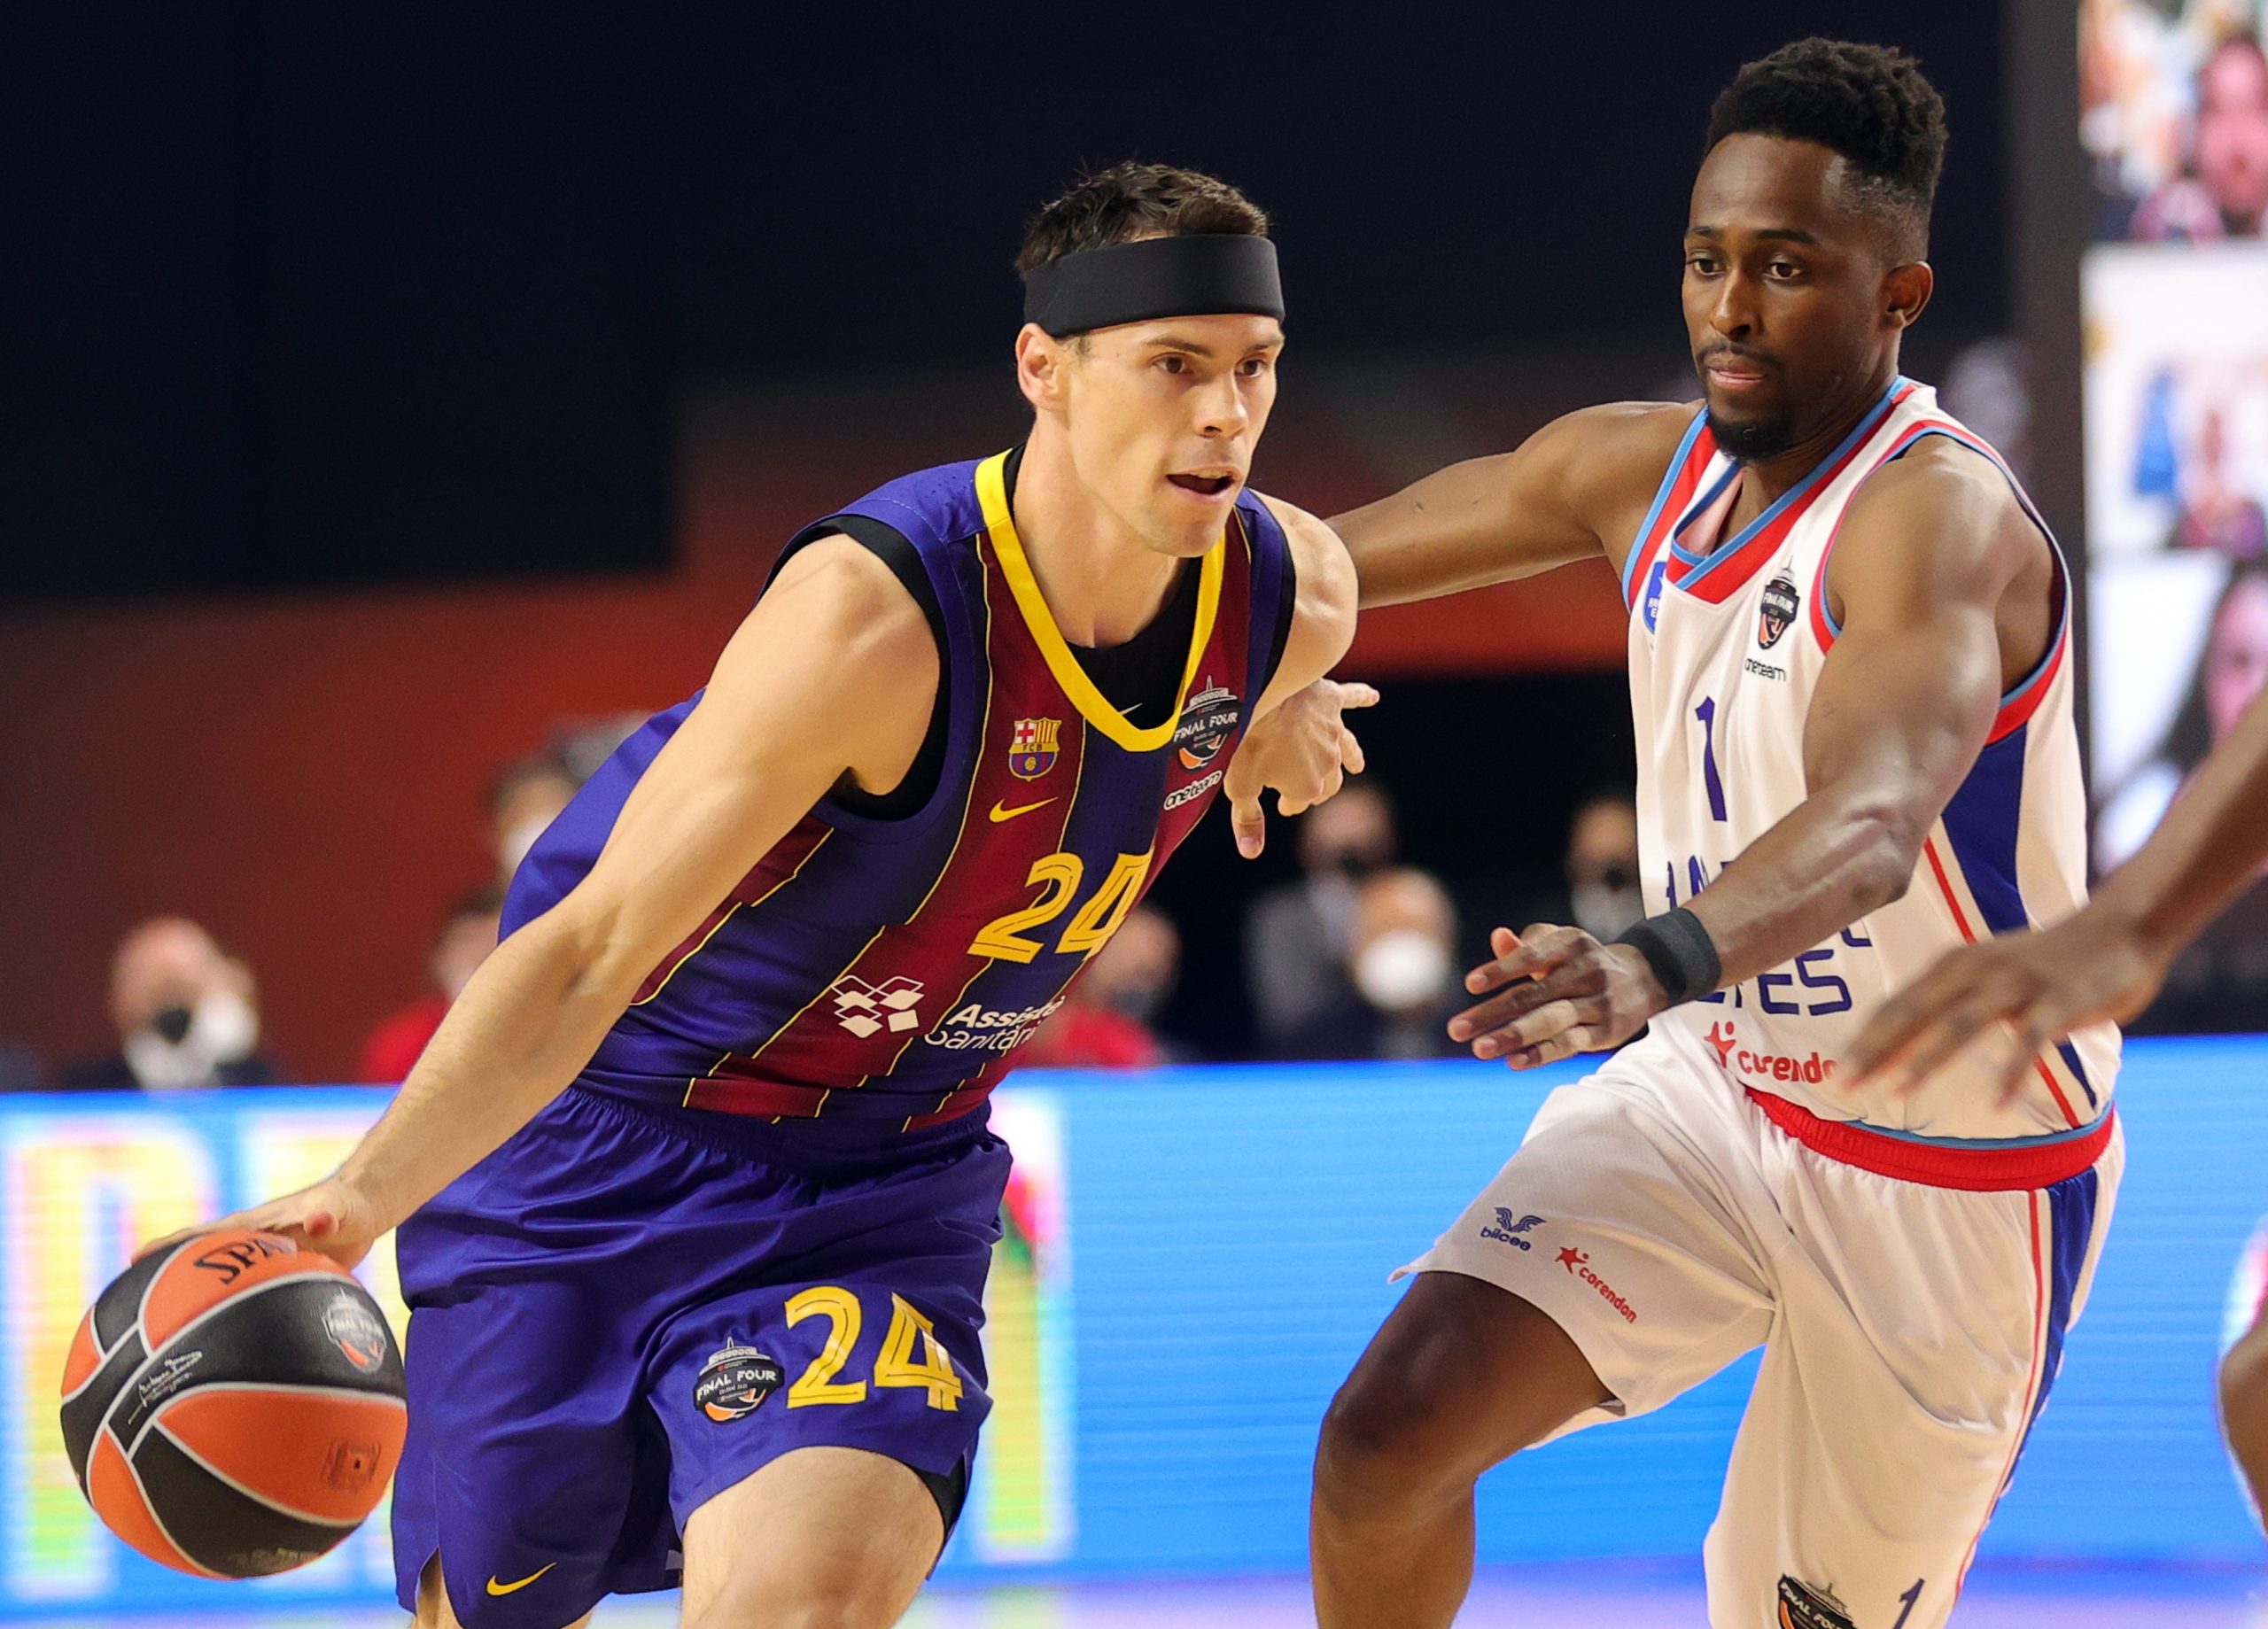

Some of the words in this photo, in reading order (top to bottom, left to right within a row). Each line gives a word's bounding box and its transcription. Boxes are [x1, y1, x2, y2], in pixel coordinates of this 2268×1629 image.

[1022, 743, 1043, 752] FCB
[1173, 719, 1206, 743] FINAL
[1208, 711, 1239, 728] FOUR
[1695, 695, 1728, 822] 1
[1164, 771, 1223, 809] oneteam
[967, 851, 1155, 965] 24
[1480, 1226, 1531, 1252] bilcee
[1579, 1267, 1638, 1324] corendon
[784, 1285, 963, 1411] 24
[696, 1373, 732, 1401] FINAL
[736, 1369, 776, 1382] FOUR
[1891, 1577, 1925, 1629] 1
